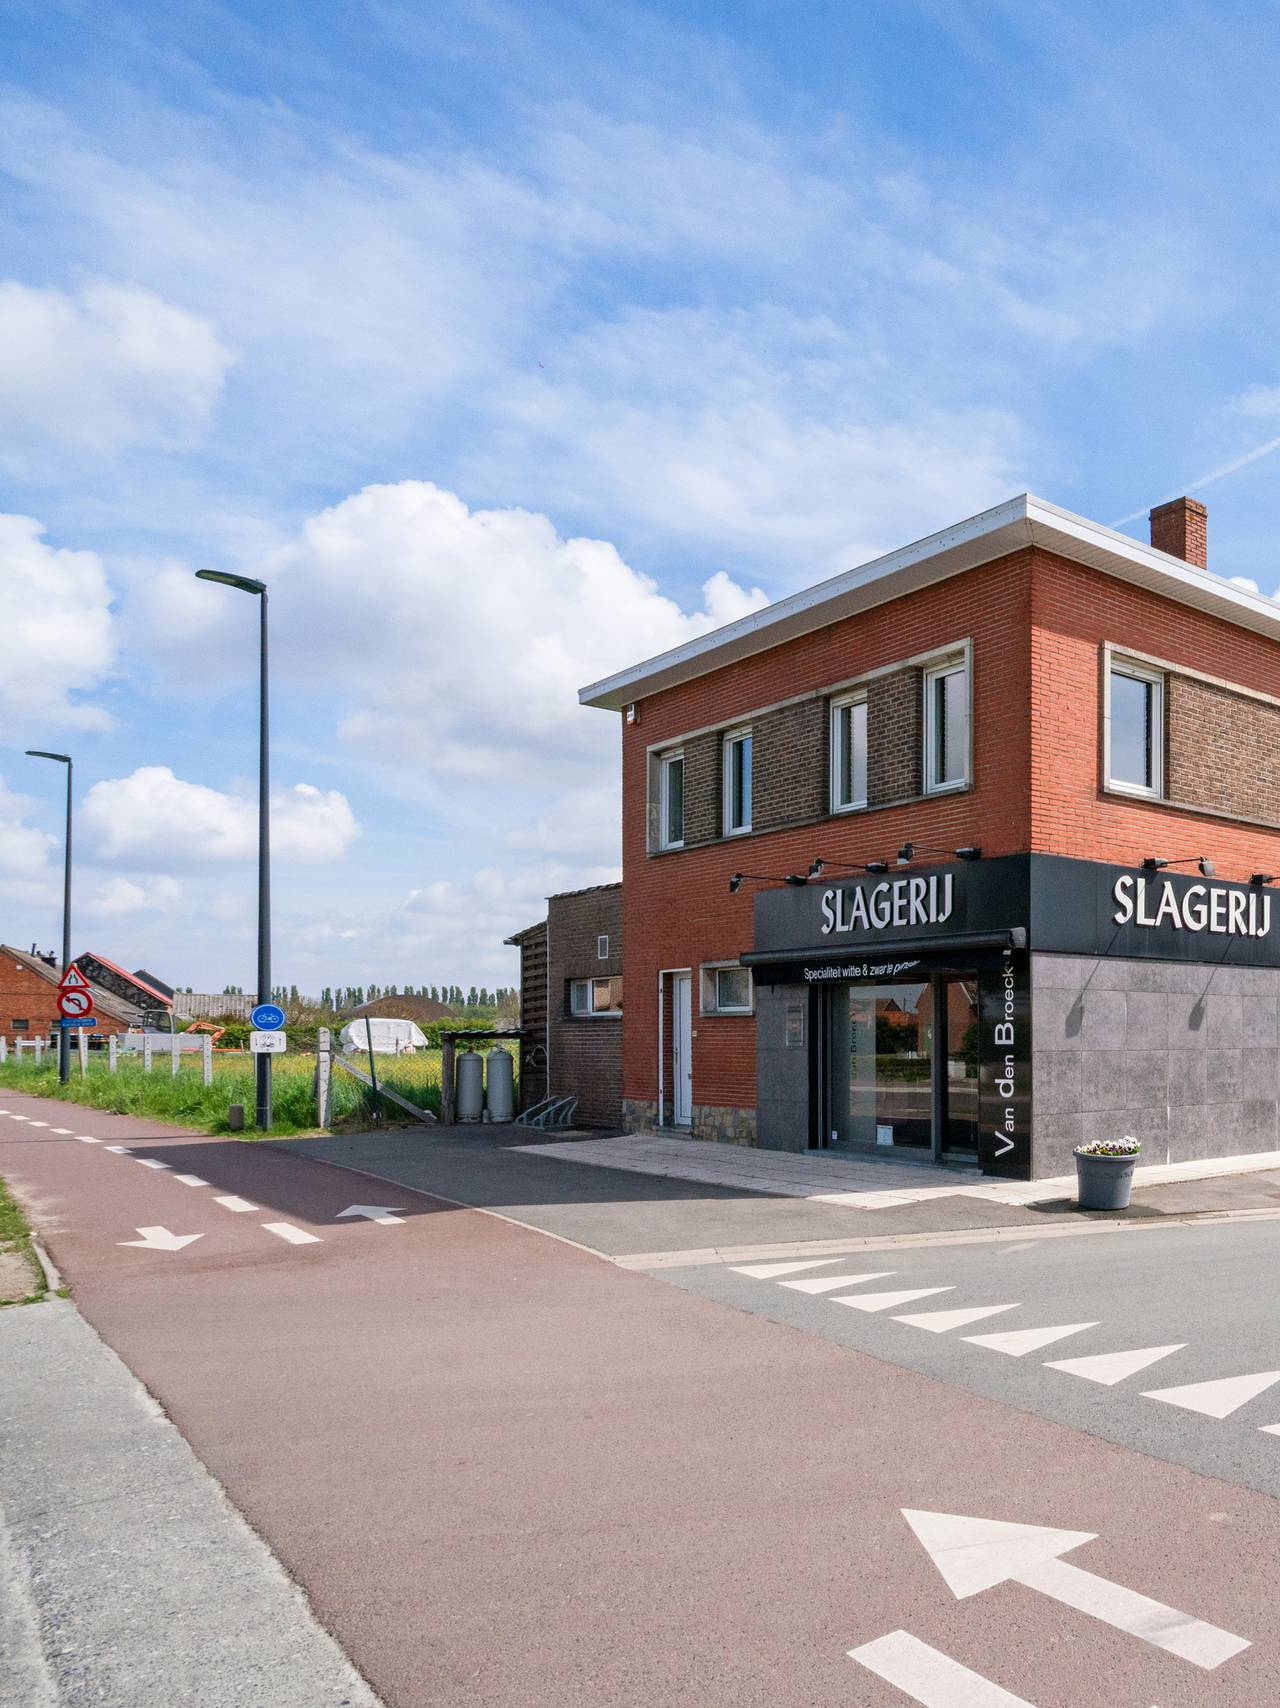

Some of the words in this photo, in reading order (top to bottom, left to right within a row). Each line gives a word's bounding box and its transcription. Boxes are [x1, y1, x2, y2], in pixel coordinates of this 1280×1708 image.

[821, 873, 953, 935] SLAGERIJ
[1114, 875, 1271, 937] SLAGERIJ
[804, 967, 841, 982] Specialiteit
[842, 965, 861, 978] witte
[862, 963, 869, 977] &
[994, 966, 1015, 1046] Broeck
[994, 1054, 1015, 1098] den
[994, 1107, 1015, 1157] Van
